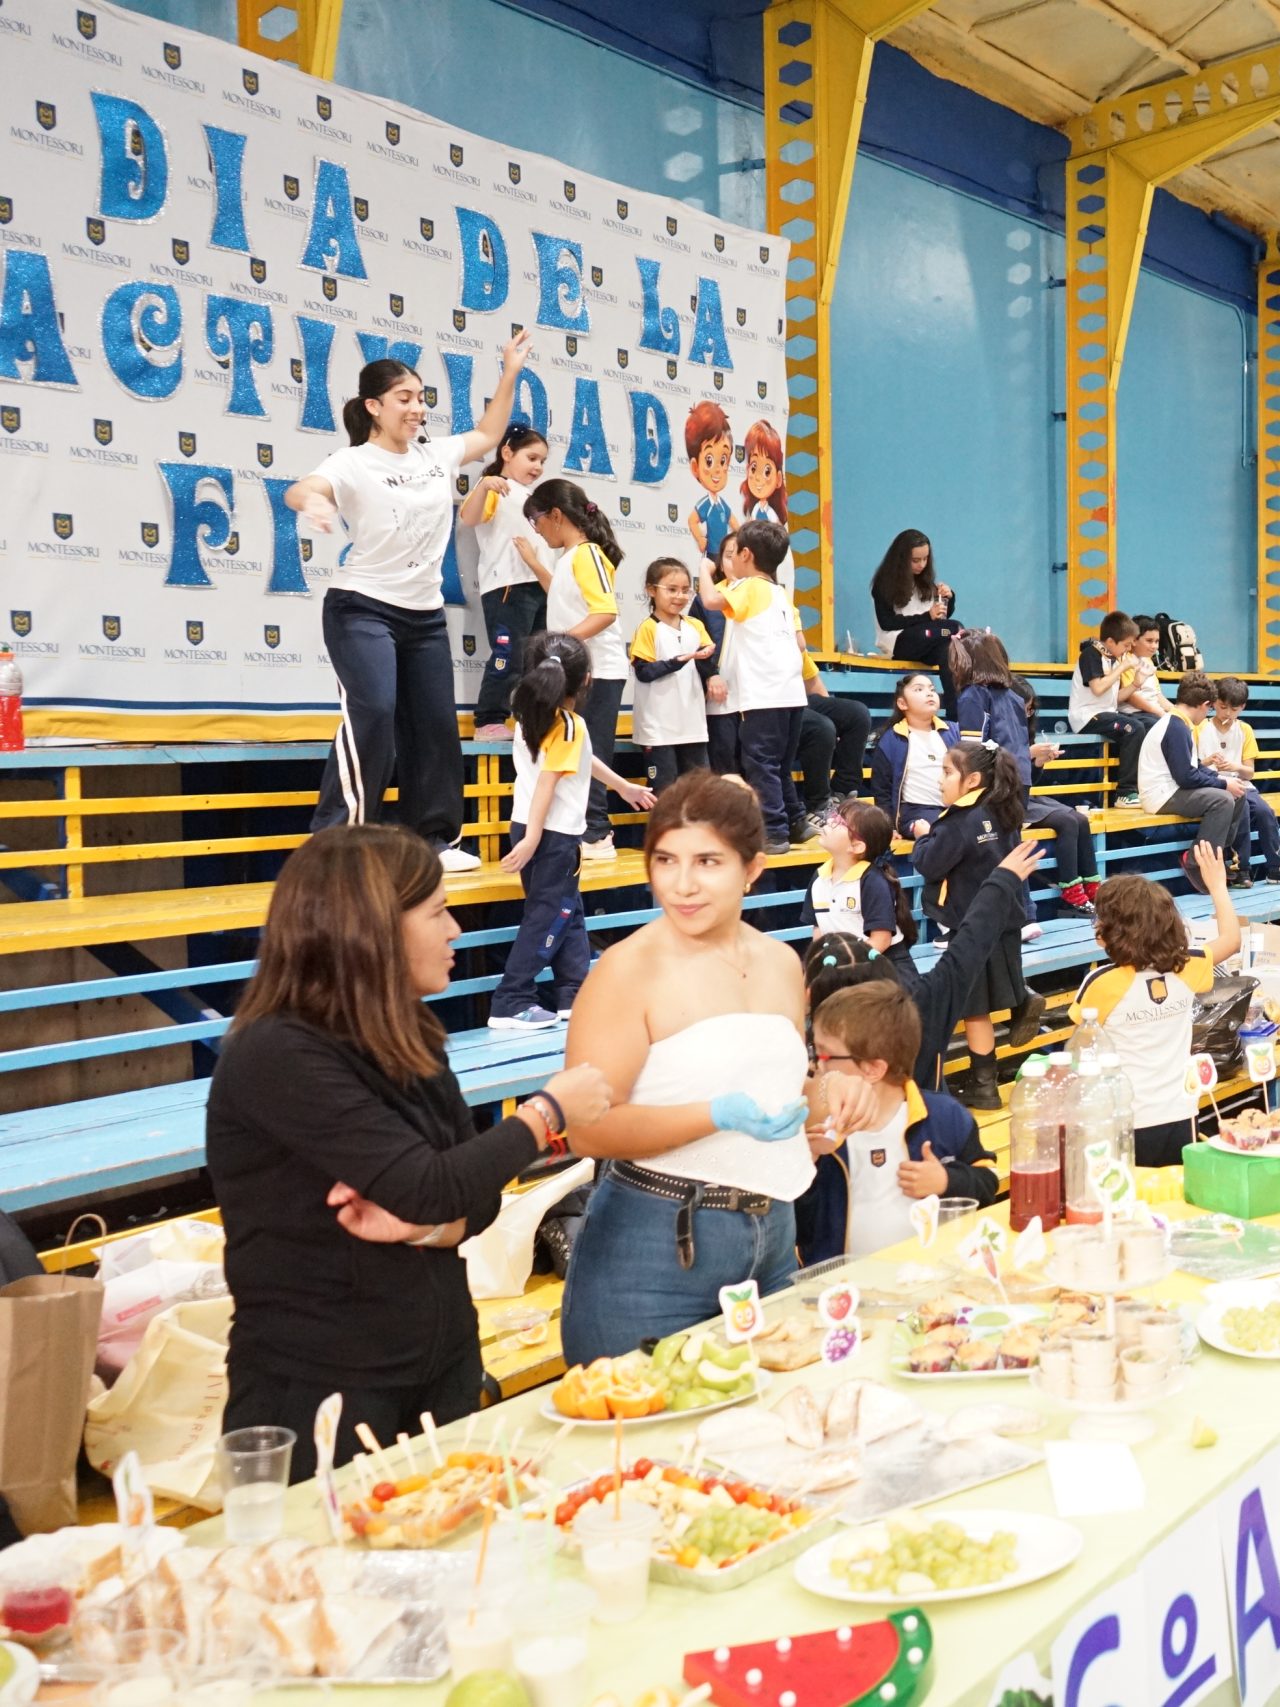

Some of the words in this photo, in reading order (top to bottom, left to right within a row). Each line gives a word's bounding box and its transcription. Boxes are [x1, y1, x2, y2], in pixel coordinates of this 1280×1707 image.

[52, 32, 123, 67] MONTESSORI
[141, 64, 205, 93] MONTESSORI
[222, 90, 281, 119] MONTESSORI
[297, 117, 352, 144] MONTESSORI
[10, 126, 84, 155] MONTESSORI
[367, 141, 419, 167] MONTESSORI
[433, 163, 481, 187] MONTESSORI
[493, 182, 537, 203] MONTESSORI
[264, 197, 310, 219] MONTESS
[549, 200, 592, 221] MONTESSORI
[89, 86, 370, 287] DIA
[453, 202, 592, 336] DE
[634, 254, 734, 373] LA
[356, 224, 389, 242] TESSORI
[602, 217, 643, 237] MONTESSORI
[0, 229, 41, 248] TESSORI
[653, 233, 691, 253] MONTESSORI
[62, 242, 131, 268] MONTESSORI
[402, 238, 452, 260] MONTESSORI
[701, 250, 738, 268] MONTESSORI
[150, 263, 213, 287] MONTESSORI
[747, 263, 780, 278] MONTESSORI
[230, 281, 288, 304] MONTESSORI
[303, 300, 358, 320] MONTESSORI
[372, 315, 423, 336] MONTESSORI
[436, 331, 483, 350] MONTESSORI
[551, 357, 592, 373] MONTESSORI
[194, 369, 230, 384] MONTE
[603, 368, 643, 385] MONTESSORI
[653, 380, 691, 395] MONTESSORI
[700, 391, 736, 405] MONTESSORI
[0, 437, 49, 453] TESSORI
[69, 446, 138, 465] MONTESSORI
[609, 518, 646, 530] ONTESSORI
[28, 541, 99, 558] MONTESSORI
[118, 550, 169, 564] MONTESS
[302, 566, 333, 578] ESSORI
[78, 643, 146, 658] MONTESSORI
[163, 649, 227, 661] MONTESSORI
[243, 652, 302, 664] MONTESSORI
